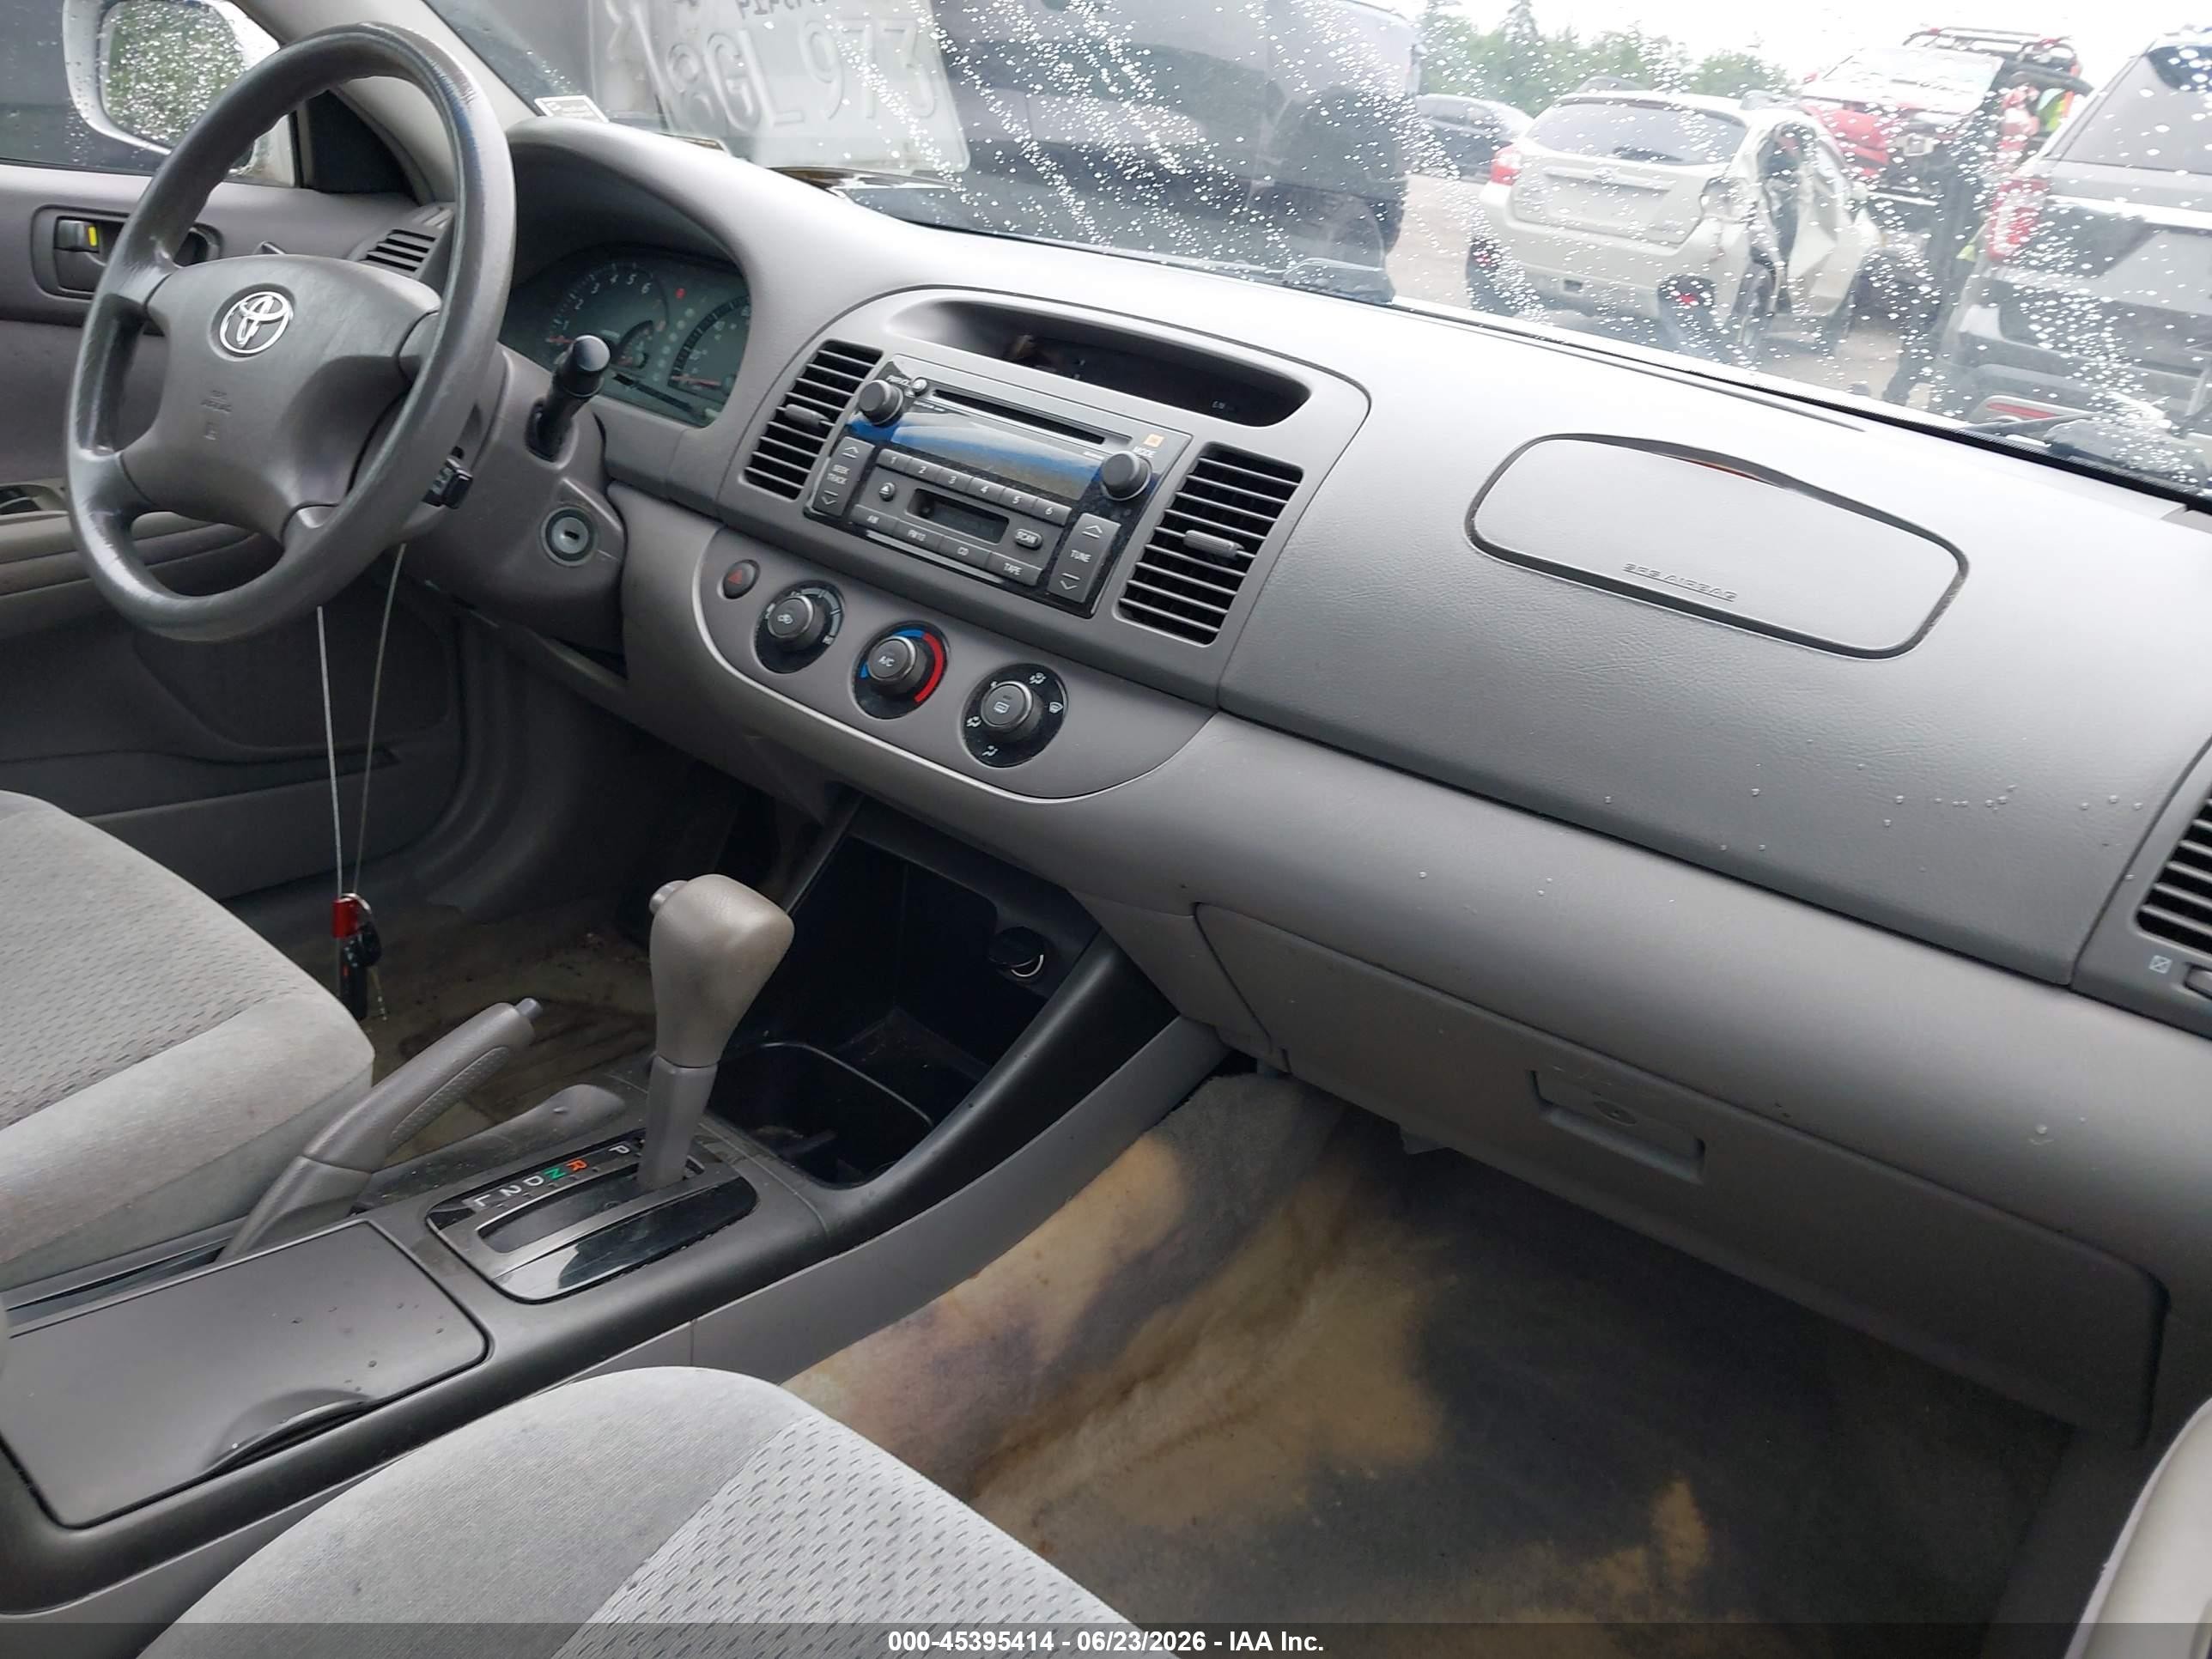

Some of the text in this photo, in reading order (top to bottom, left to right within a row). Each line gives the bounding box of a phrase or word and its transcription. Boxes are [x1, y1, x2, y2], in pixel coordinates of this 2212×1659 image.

[641, 283, 652, 295] 6
[889, 456, 1054, 515] 1 2 3 4 5 6
[1015, 531, 1038, 544] SCAN
[957, 546, 969, 556] CD
[1070, 550, 1092, 562] TUNE
[1003, 562, 1023, 575] TAPE
[878, 655, 895, 667] A/C
[609, 1145, 630, 1154] P
[566, 1159, 587, 1170] R
[544, 1168, 566, 1180] N
[523, 1175, 544, 1186] D
[500, 1185, 521, 1196] 2
[473, 1194, 491, 1207] L
